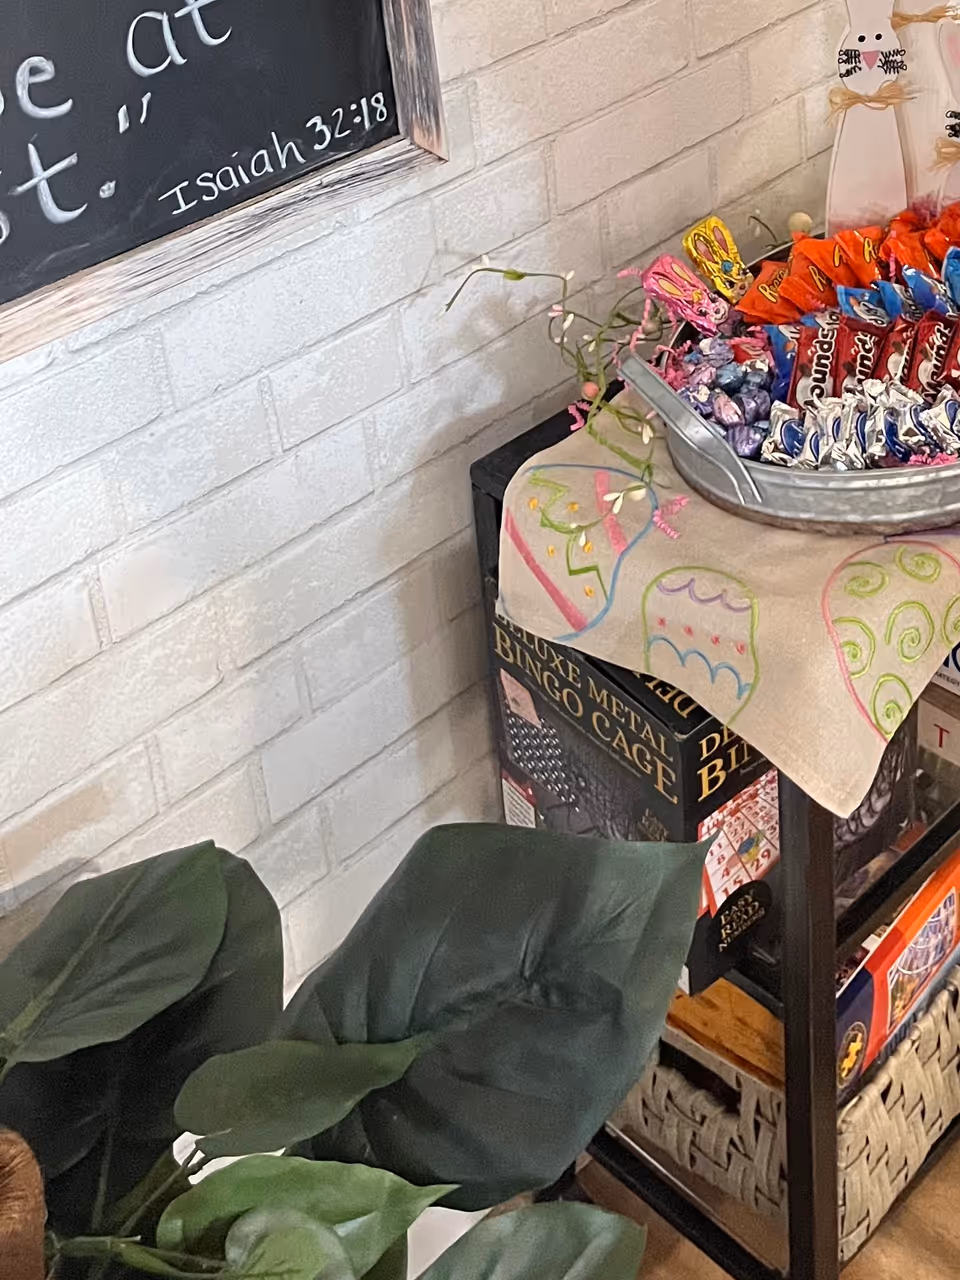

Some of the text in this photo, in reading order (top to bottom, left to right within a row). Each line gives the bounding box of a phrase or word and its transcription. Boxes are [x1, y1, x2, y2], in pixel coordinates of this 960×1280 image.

[158, 91, 388, 215] Isaiah 32:18
[493, 622, 584, 718] BINGO
[592, 711, 679, 805] CAGE
[588, 676, 674, 763] METAL
